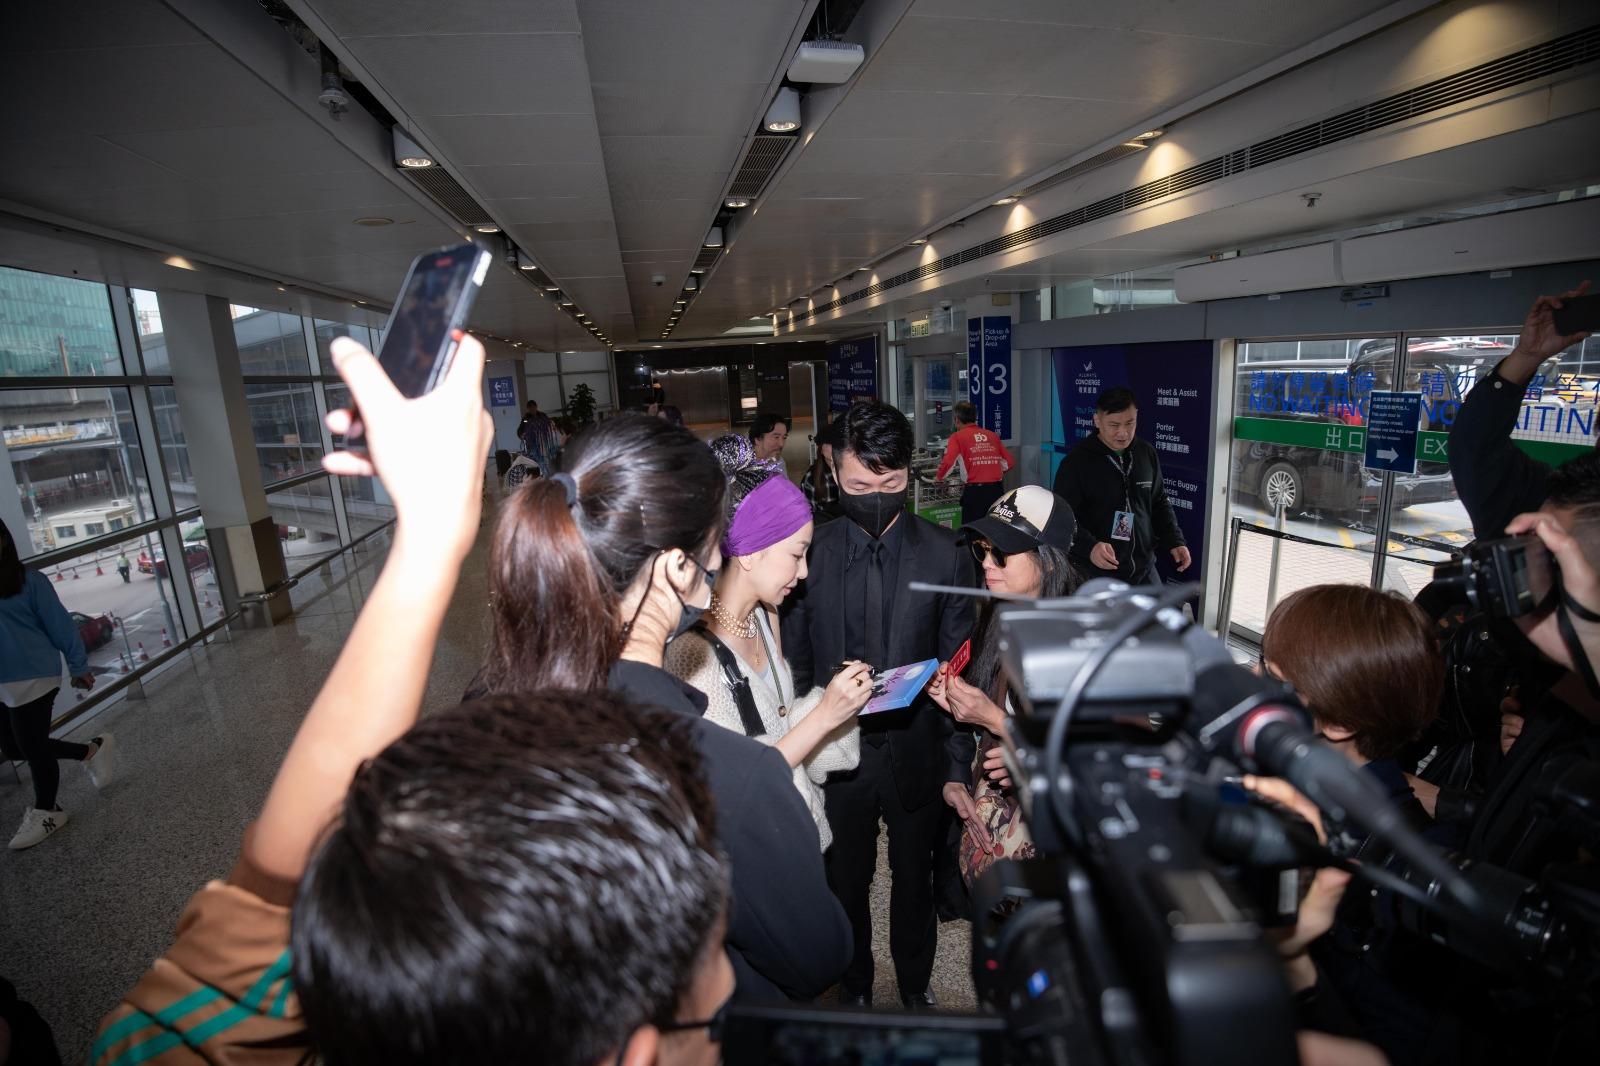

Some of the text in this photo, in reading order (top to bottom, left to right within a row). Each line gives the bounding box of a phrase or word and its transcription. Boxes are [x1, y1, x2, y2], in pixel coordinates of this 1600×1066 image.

[971, 364, 980, 395] 3
[988, 363, 1007, 395] 3
[1157, 388, 1198, 397] Meet & Assist
[1249, 394, 1277, 414] NO
[1156, 423, 1174, 431] Porter
[1155, 432, 1180, 441] Services
[1326, 427, 1364, 449] 出口
[1423, 439, 1448, 456] EX
[1177, 480, 1198, 492] Buggy
